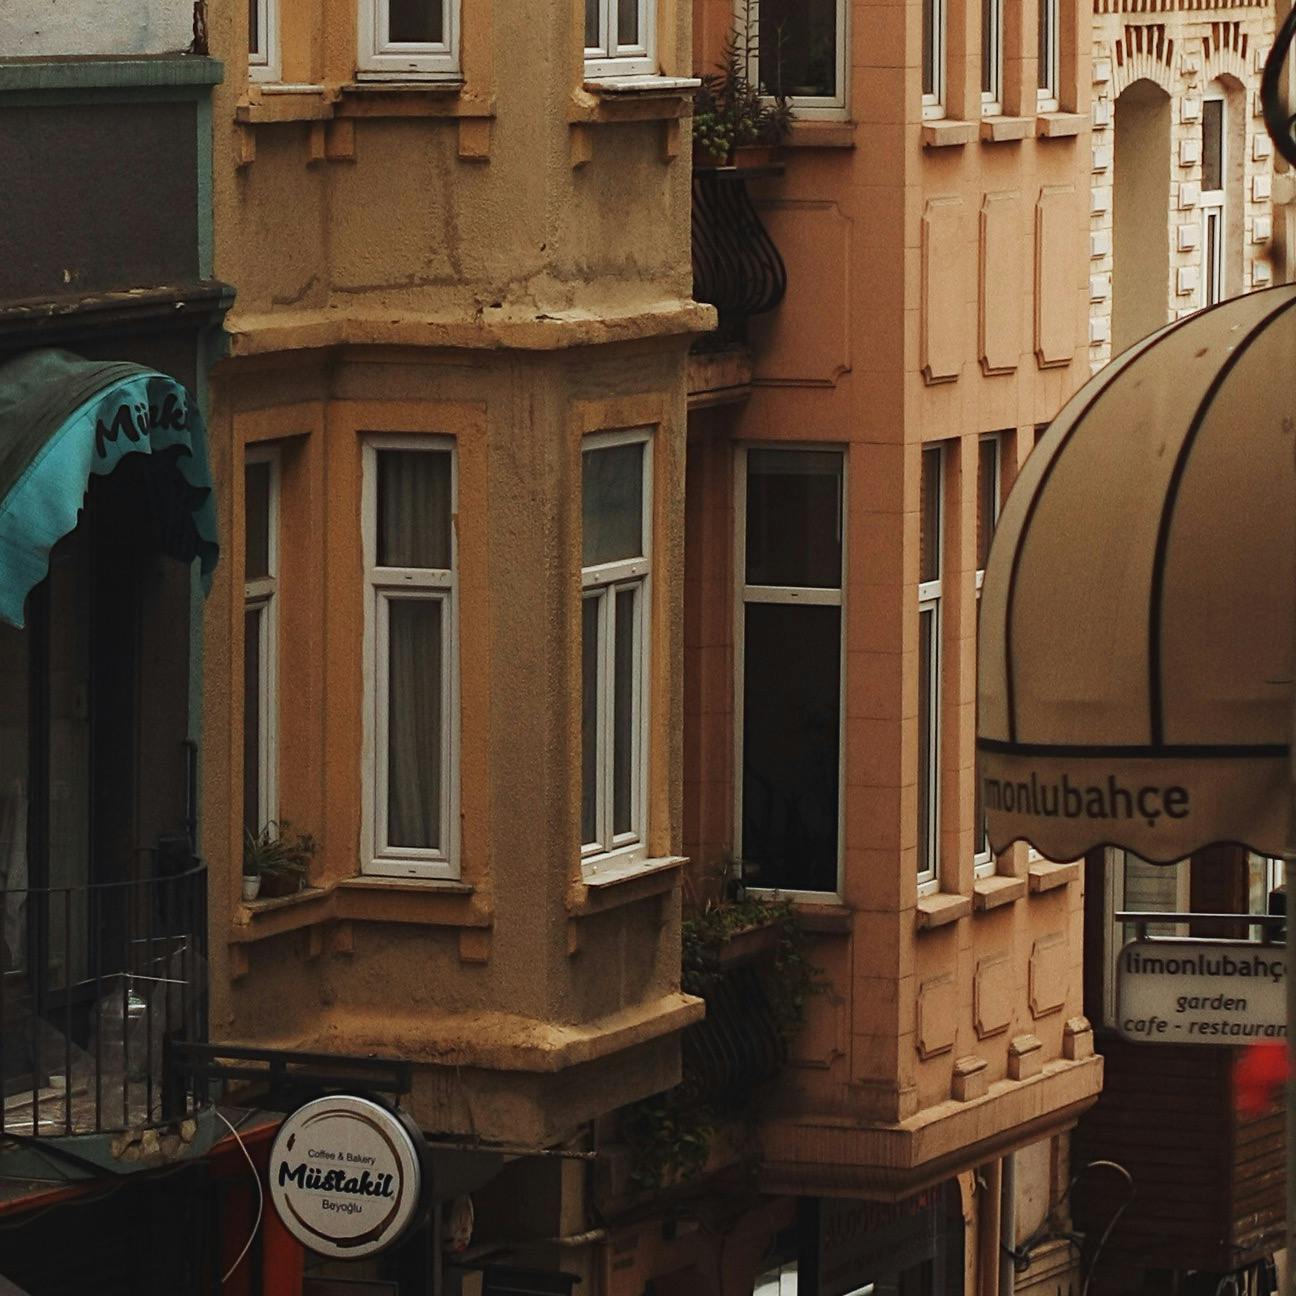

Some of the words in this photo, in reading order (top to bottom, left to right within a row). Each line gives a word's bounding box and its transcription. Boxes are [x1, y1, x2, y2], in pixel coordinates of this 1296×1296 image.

[1125, 952, 1287, 983] limonlubahç
[1176, 993, 1247, 1013] garden
[1123, 1016, 1168, 1036] cafe
[1189, 1020, 1287, 1036] restauran
[308, 1149, 336, 1161] Coffee
[338, 1152, 344, 1161] &
[346, 1153, 376, 1165] Bakery
[279, 1161, 394, 1197] Müstakil
